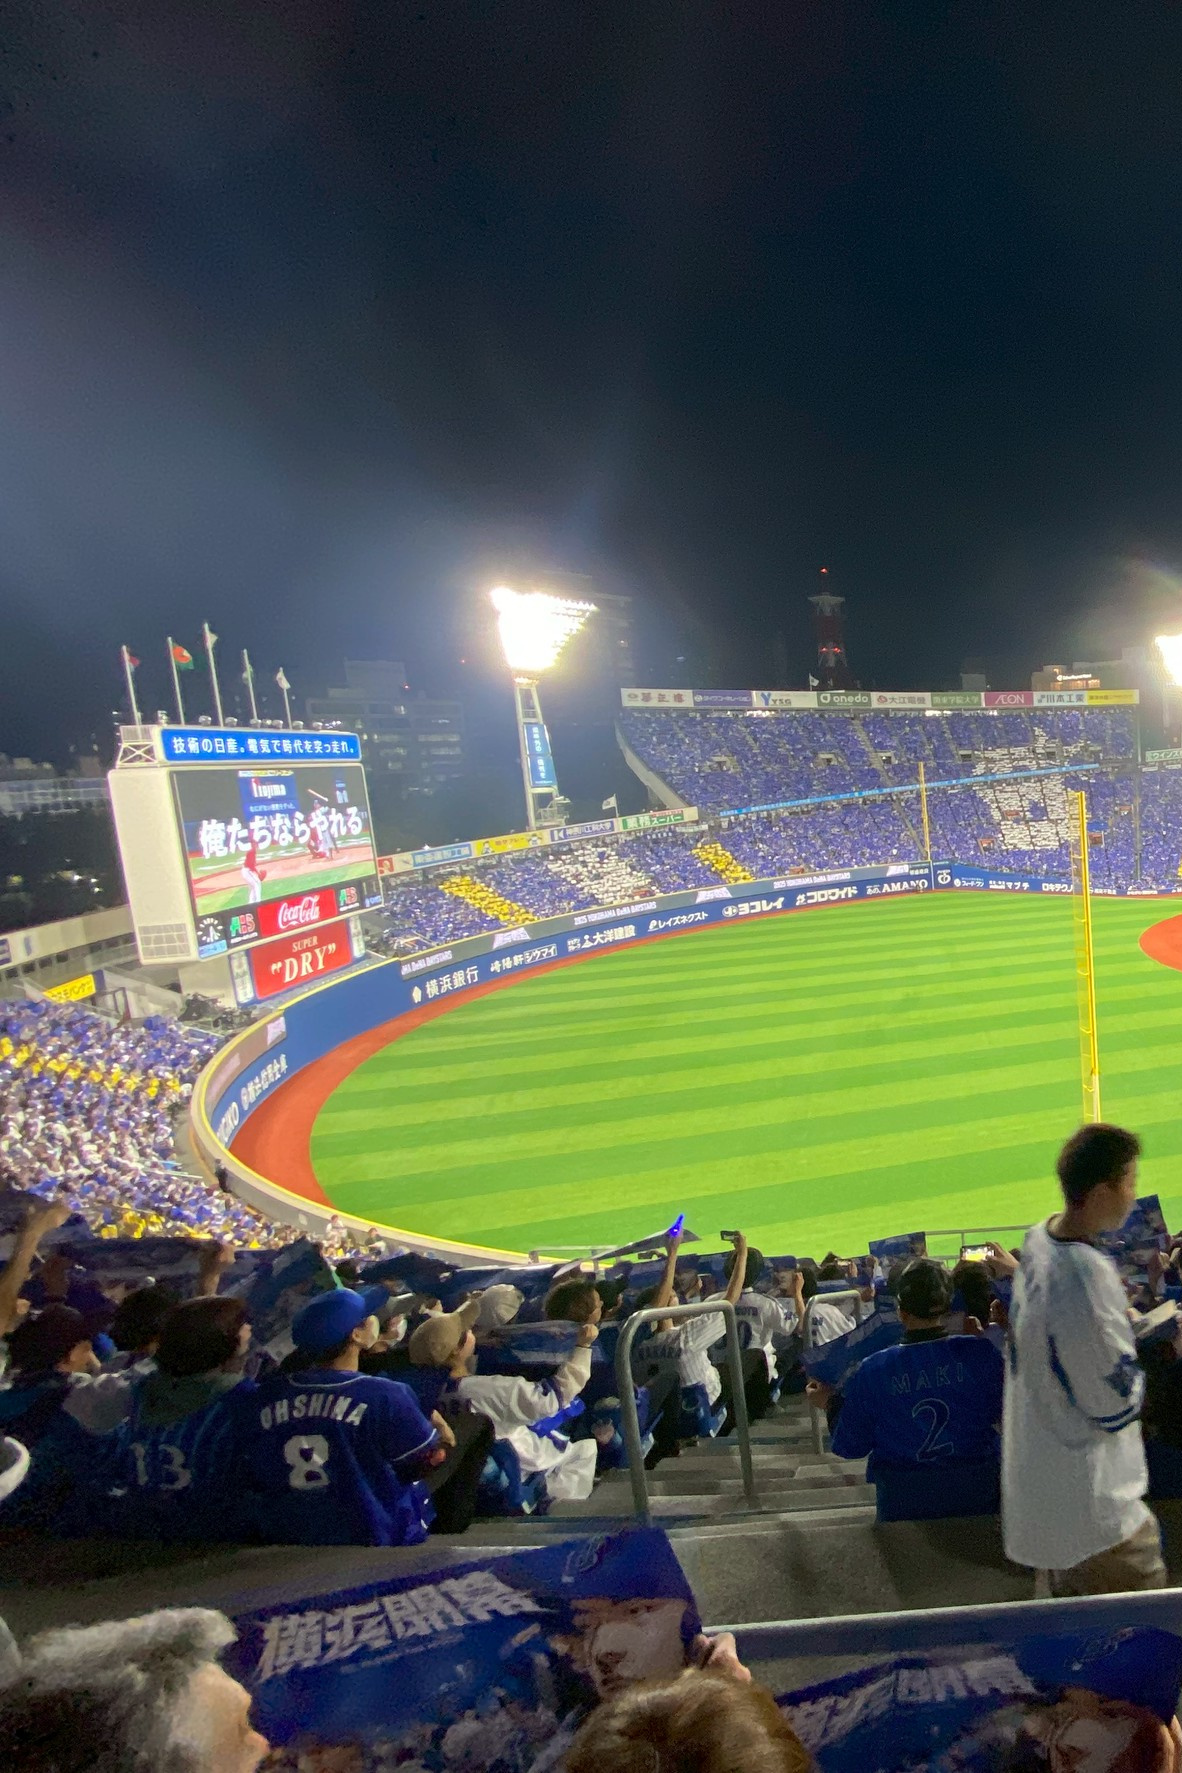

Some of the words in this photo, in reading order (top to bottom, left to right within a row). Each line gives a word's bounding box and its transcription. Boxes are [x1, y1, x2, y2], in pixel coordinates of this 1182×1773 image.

[626, 814, 683, 829] 業務スーパー
[199, 806, 363, 859] 俺たちならやれる
[806, 886, 858, 904] コロワイド
[882, 879, 928, 893] AMANO
[1005, 881, 1030, 890] マブチ
[1042, 882, 1073, 892] ロキテクノ
[737, 897, 785, 916] ヨコレイ
[658, 911, 709, 929] レイズネクスト
[292, 935, 318, 953] SUPER
[592, 924, 636, 946] 大洋建設
[425, 965, 479, 999] 横浜銀行
[891, 1362, 964, 1397] MAKI
[259, 1392, 369, 1431] OHSHIMA
[911, 1398, 954, 1462] 2
[132, 1443, 192, 1491] 13
[284, 1434, 330, 1490] 8
